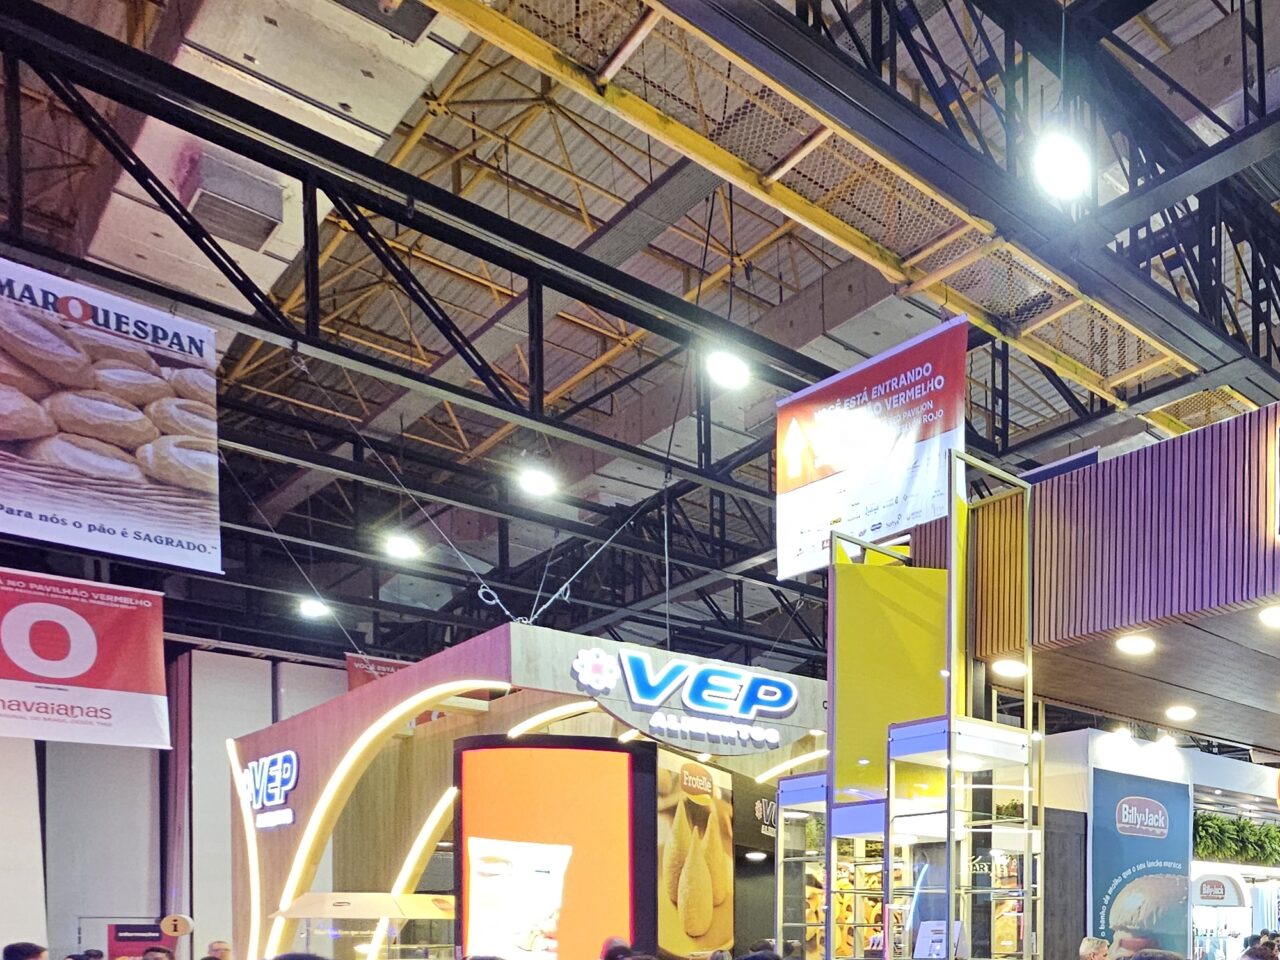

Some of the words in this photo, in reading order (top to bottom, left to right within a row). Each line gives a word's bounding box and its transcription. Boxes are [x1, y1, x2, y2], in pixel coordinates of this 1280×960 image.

[0, 277, 206, 358] MARQUESPAN
[871, 362, 932, 399] ENTRANDO
[884, 375, 945, 411] VERMELHO
[921, 409, 944, 423] ROJO
[38, 513, 68, 526] nós
[73, 520, 82, 529] o
[88, 523, 117, 536] pão
[29, 583, 89, 598] PAVILHÃO
[91, 592, 153, 608] VERMELHO
[0, 602, 98, 679] O
[618, 649, 799, 721] VEP
[247, 750, 298, 810] VEP
[1145, 808, 1165, 829] Jack
[1098, 905, 1107, 930] banho
[1107, 875, 1123, 895] molho
